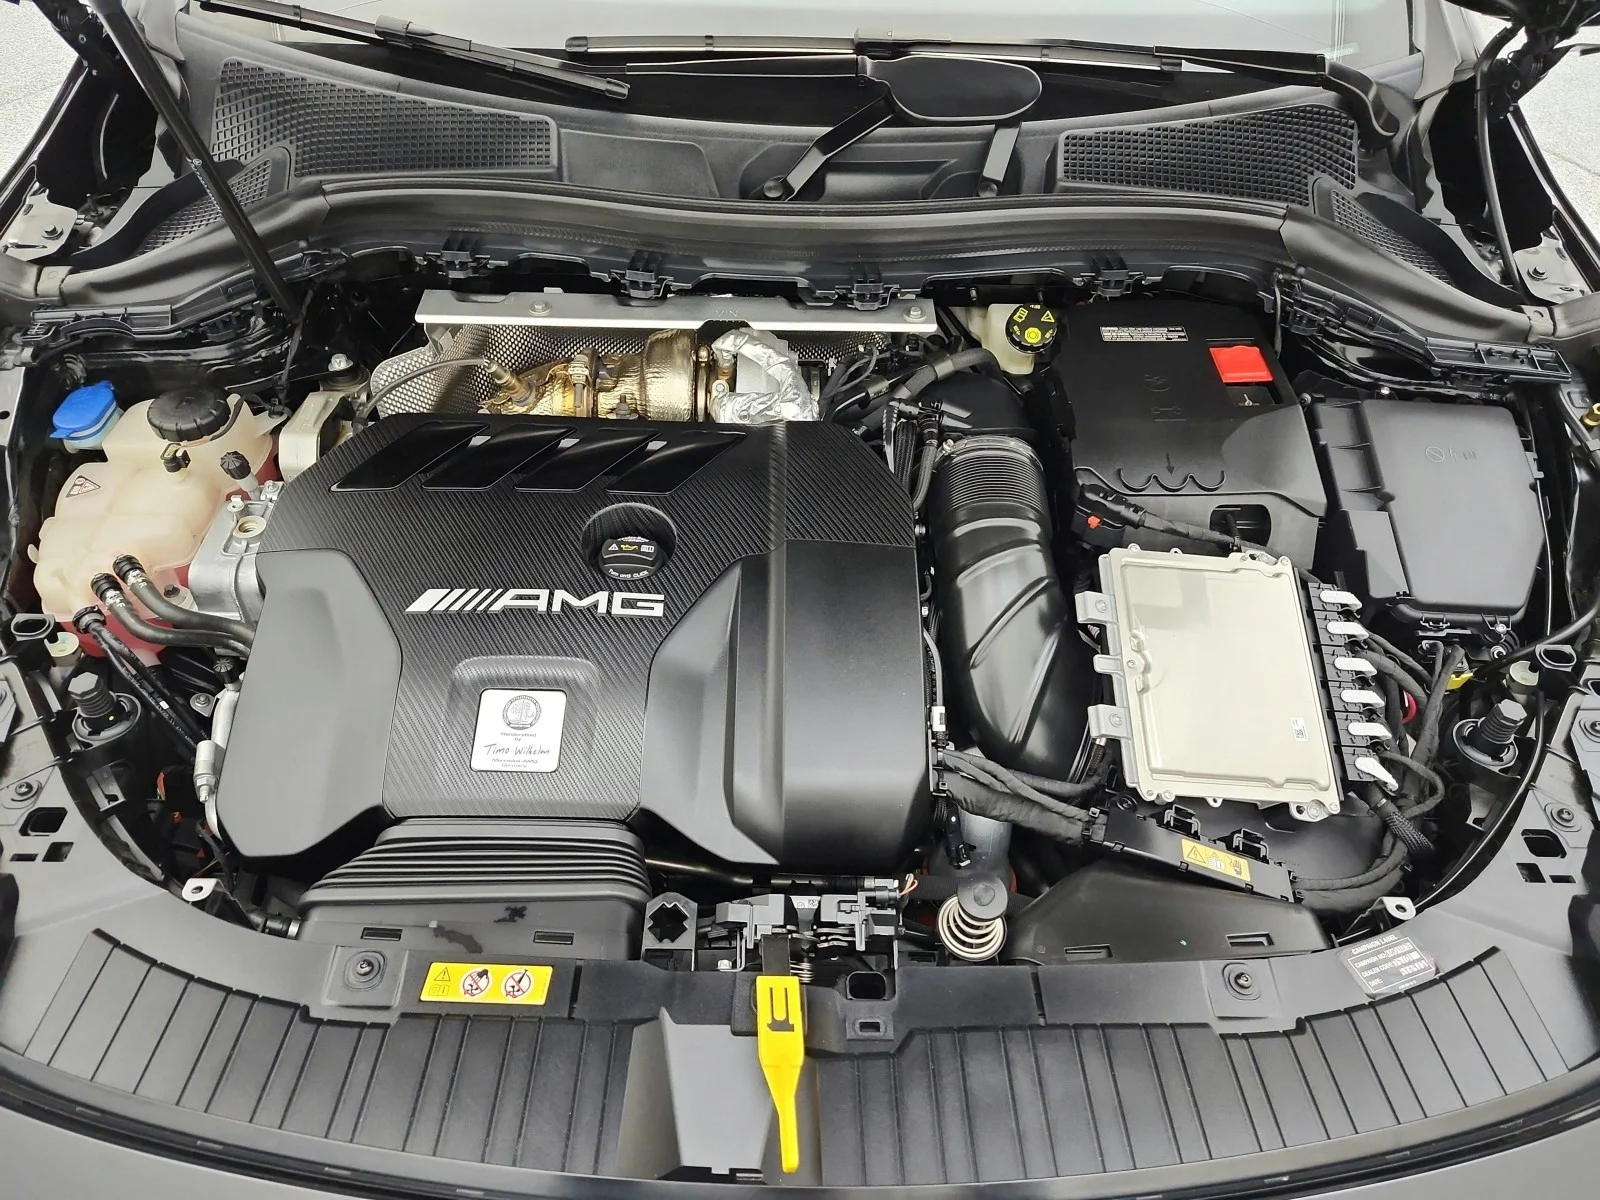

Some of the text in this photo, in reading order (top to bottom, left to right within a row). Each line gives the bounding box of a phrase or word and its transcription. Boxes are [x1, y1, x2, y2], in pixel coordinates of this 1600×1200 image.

[488, 588, 665, 618] AMG
[484, 743, 551, 756] Timo Wilhelm
[1351, 940, 1380, 955] CAMPAIGN
[1380, 934, 1398, 945] LABEL
